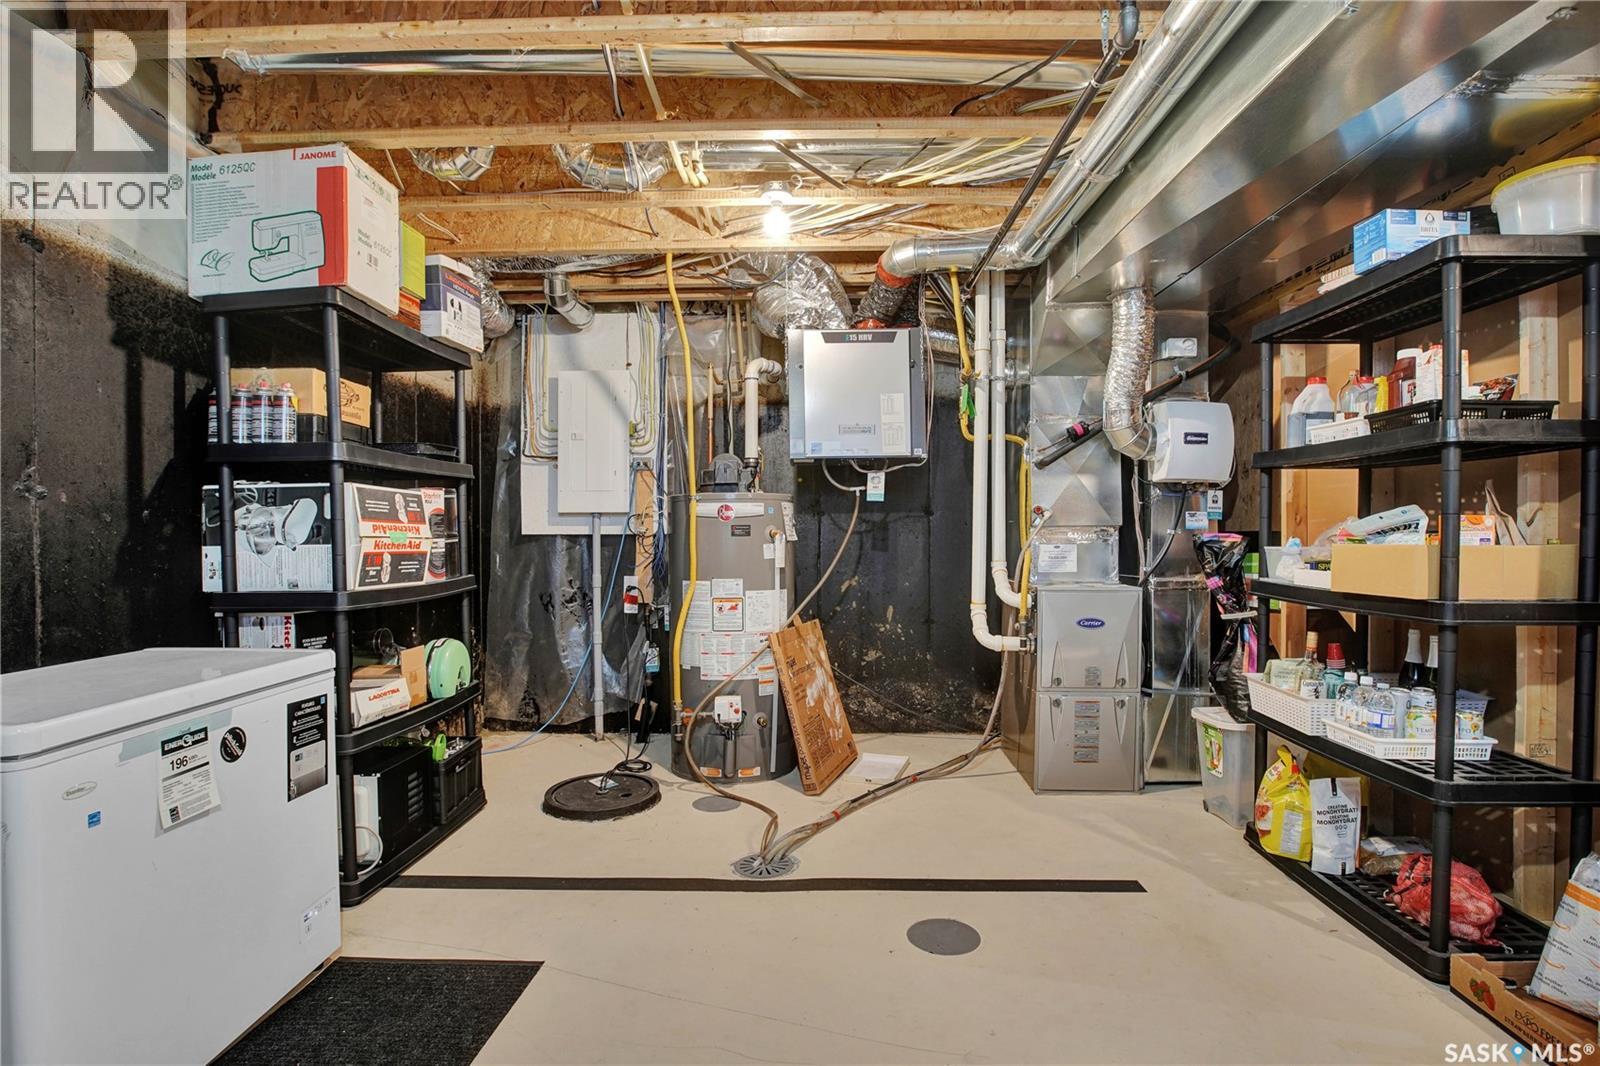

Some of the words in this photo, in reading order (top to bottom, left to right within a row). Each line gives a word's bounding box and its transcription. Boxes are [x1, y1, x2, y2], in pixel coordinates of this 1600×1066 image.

[299, 150, 337, 161] JANOME
[190, 162, 213, 173] Model
[218, 161, 257, 175] 6125QC
[190, 171, 217, 182] Modèle
[374, 540, 422, 550] KitchenAid
[1080, 618, 1102, 627] Carrier
[170, 756, 188, 771] 196
